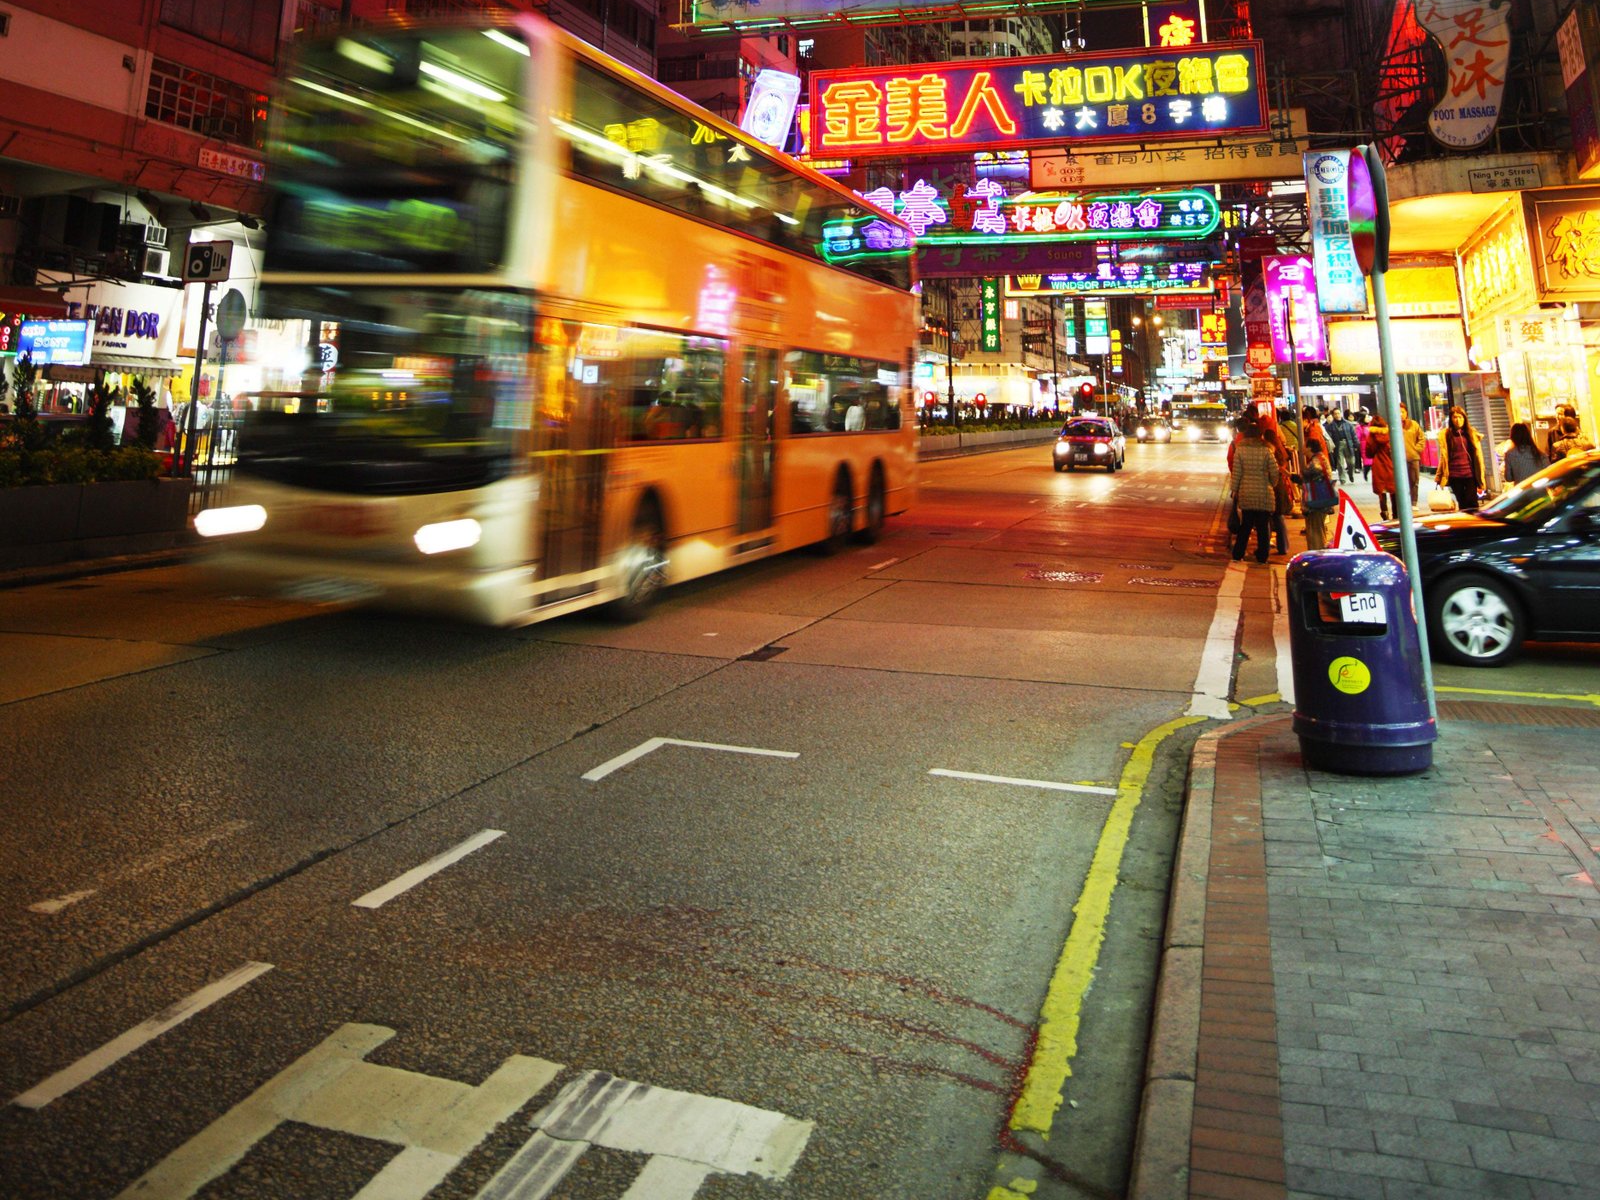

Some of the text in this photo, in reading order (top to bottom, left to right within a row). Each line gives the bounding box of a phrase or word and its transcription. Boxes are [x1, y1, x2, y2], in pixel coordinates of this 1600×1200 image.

[1014, 54, 1250, 106] 卡拉OK夜總會
[822, 71, 1016, 144] 金美人
[1433, 105, 1498, 121] FOOT MASSAGE
[1473, 167, 1535, 180] Ning Po Street
[1048, 249, 1082, 259] Sauna
[1051, 278, 1189, 290] WINDSOR PALACE HOTEL
[125, 310, 160, 339] DOR
[1520, 321, 1545, 343] 藥
[34, 337, 70, 348] SONY
[1350, 592, 1377, 612] End
